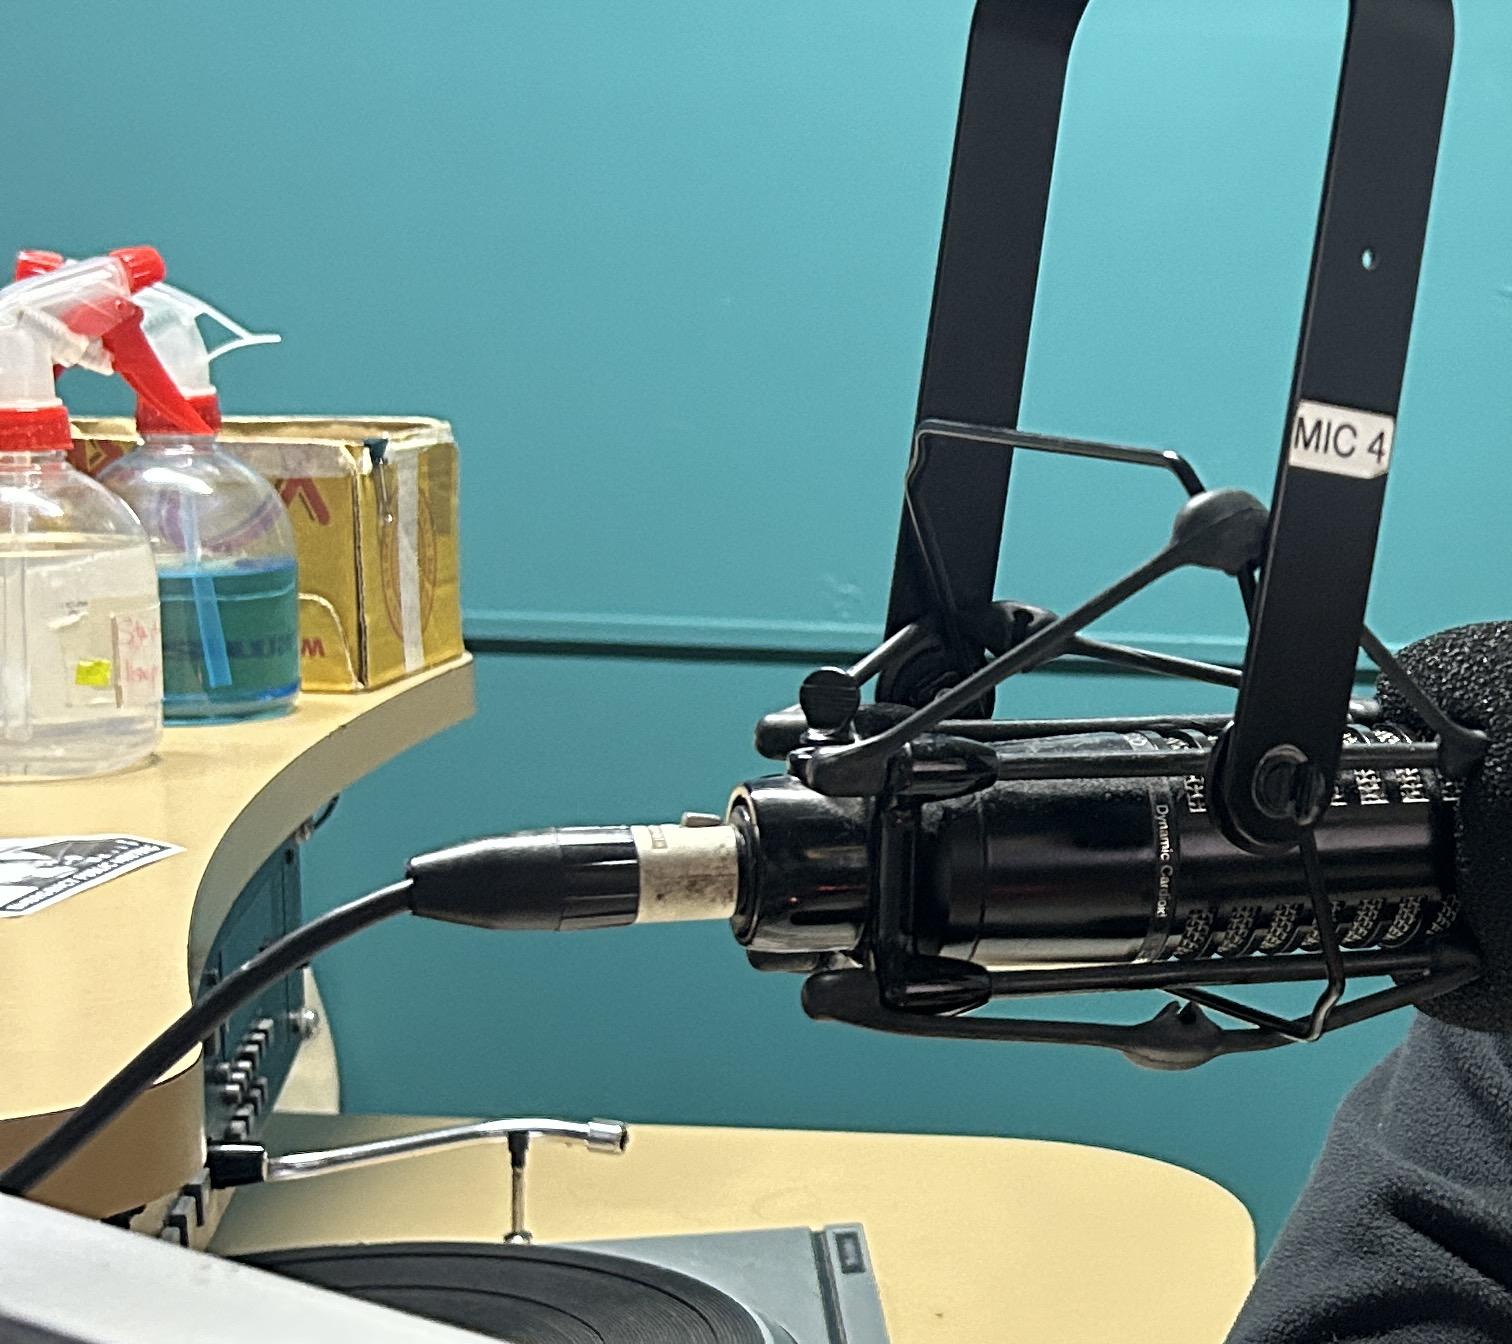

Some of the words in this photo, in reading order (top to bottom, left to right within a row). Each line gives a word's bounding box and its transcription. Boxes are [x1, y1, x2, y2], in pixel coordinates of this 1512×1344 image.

[1294, 417, 1358, 458] MIC
[1367, 431, 1386, 464] 4
[1154, 804, 1173, 861] Dynamic
